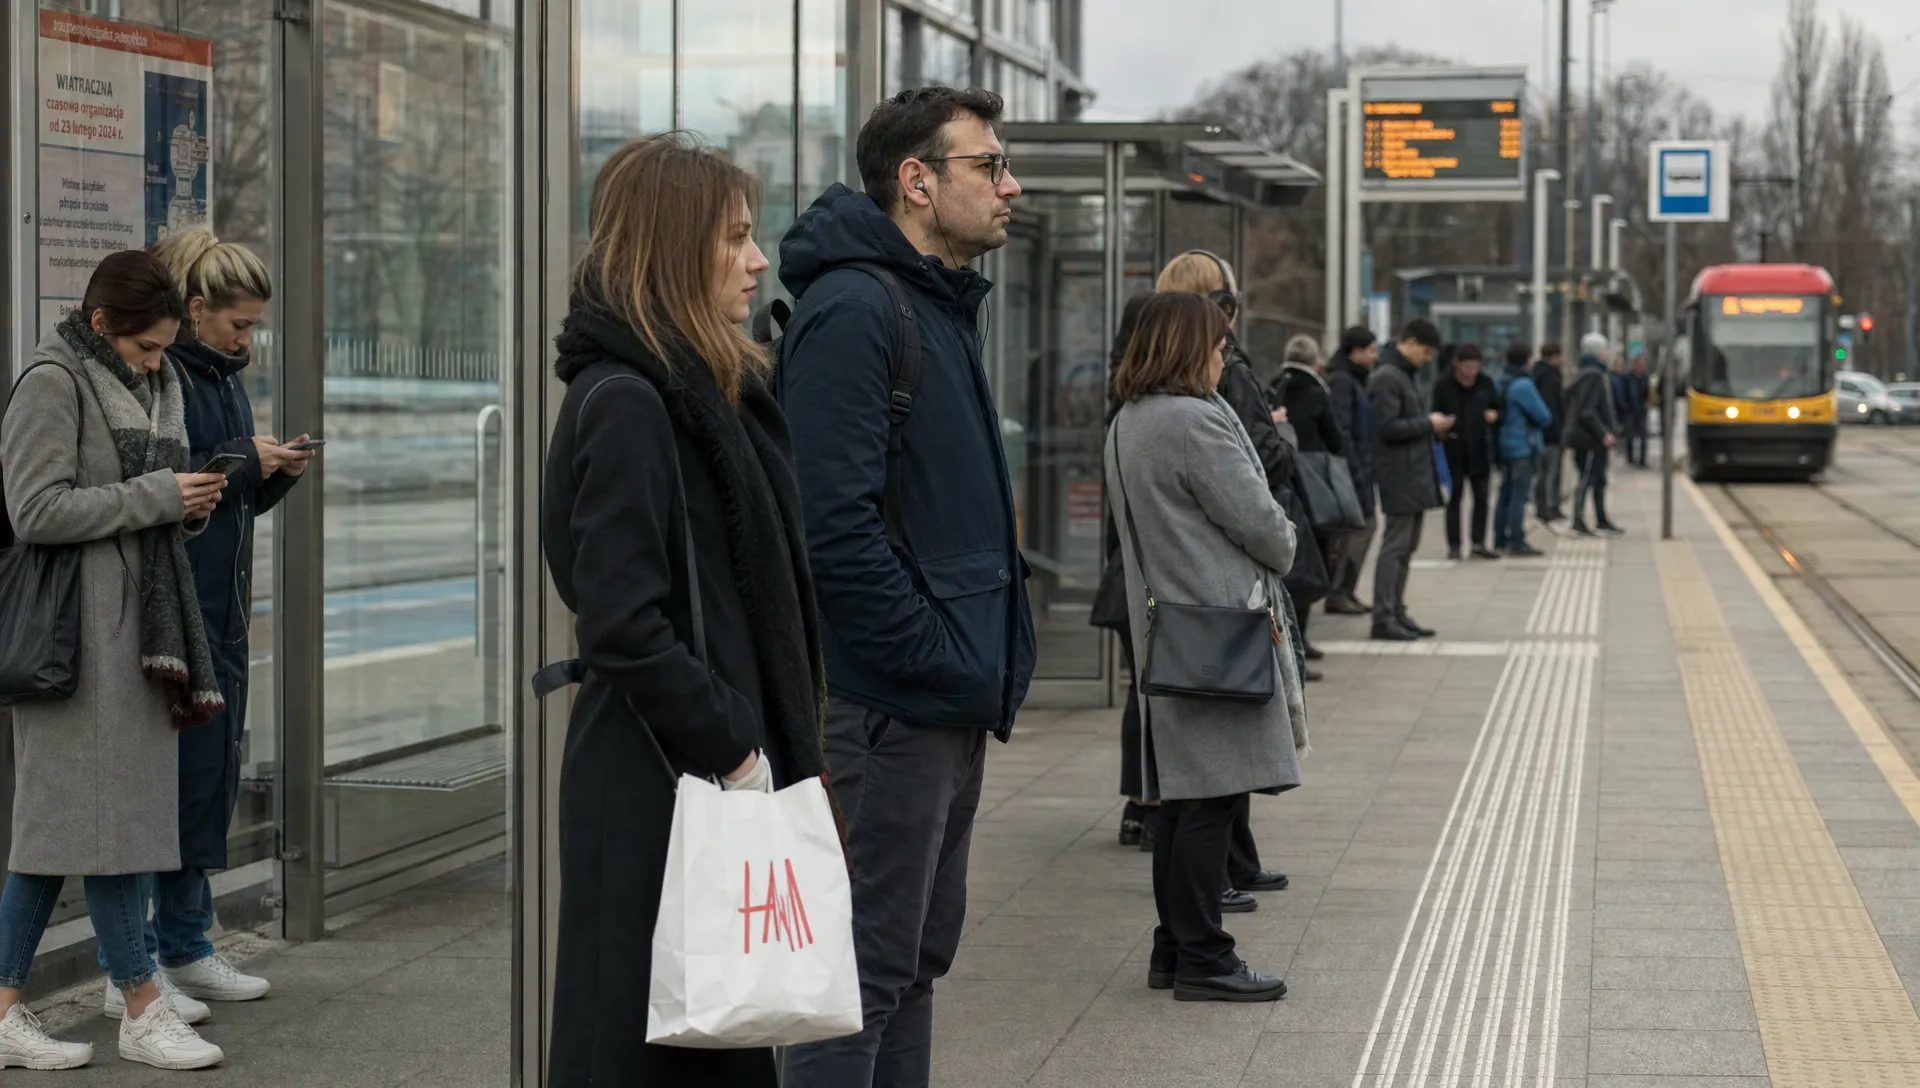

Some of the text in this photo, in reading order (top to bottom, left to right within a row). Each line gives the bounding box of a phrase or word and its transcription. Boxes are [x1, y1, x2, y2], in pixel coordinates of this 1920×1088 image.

[56, 73, 113, 98] WIATRACZNA
[46, 98, 124, 122] czasowa organizacja
[49, 117, 124, 140] od 23 lutego 2024 r.
